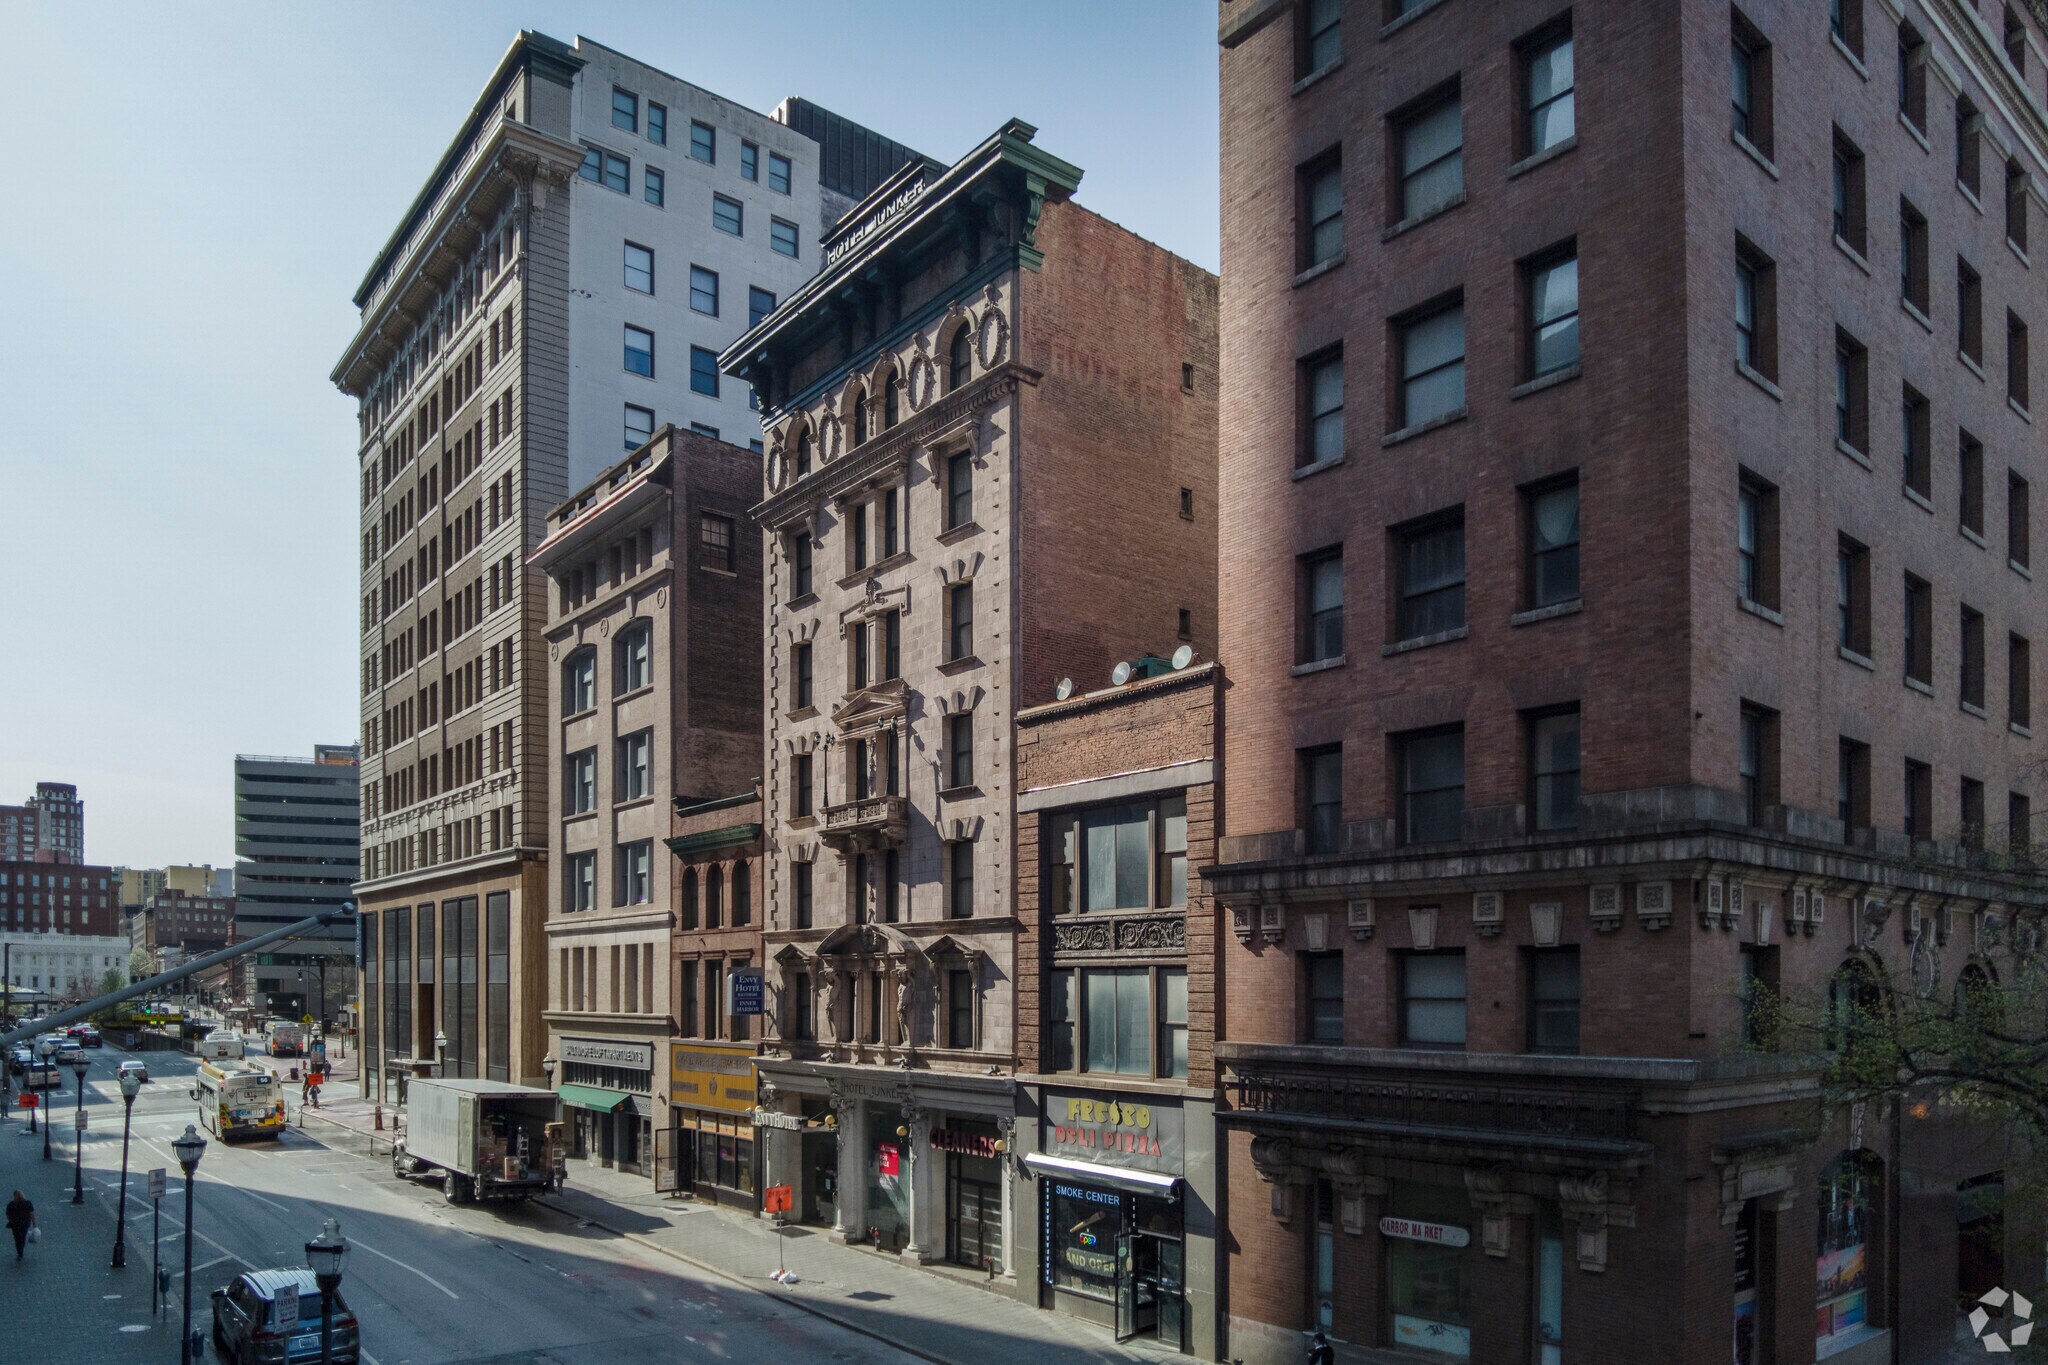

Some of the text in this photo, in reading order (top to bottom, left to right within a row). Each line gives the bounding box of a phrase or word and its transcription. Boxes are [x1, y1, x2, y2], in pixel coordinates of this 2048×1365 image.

[827, 226, 865, 265] HOTEL
[735, 984, 761, 992] HOTEL
[843, 1082, 868, 1096] HOTEL
[774, 1112, 798, 1131] HOTEL
[929, 1128, 995, 1159] CLEANERS
[1055, 1125, 1162, 1157] DELI PIZZA
[1055, 1185, 1120, 1206] SMOKE CENTER
[1381, 1220, 1409, 1235] HARBOR
